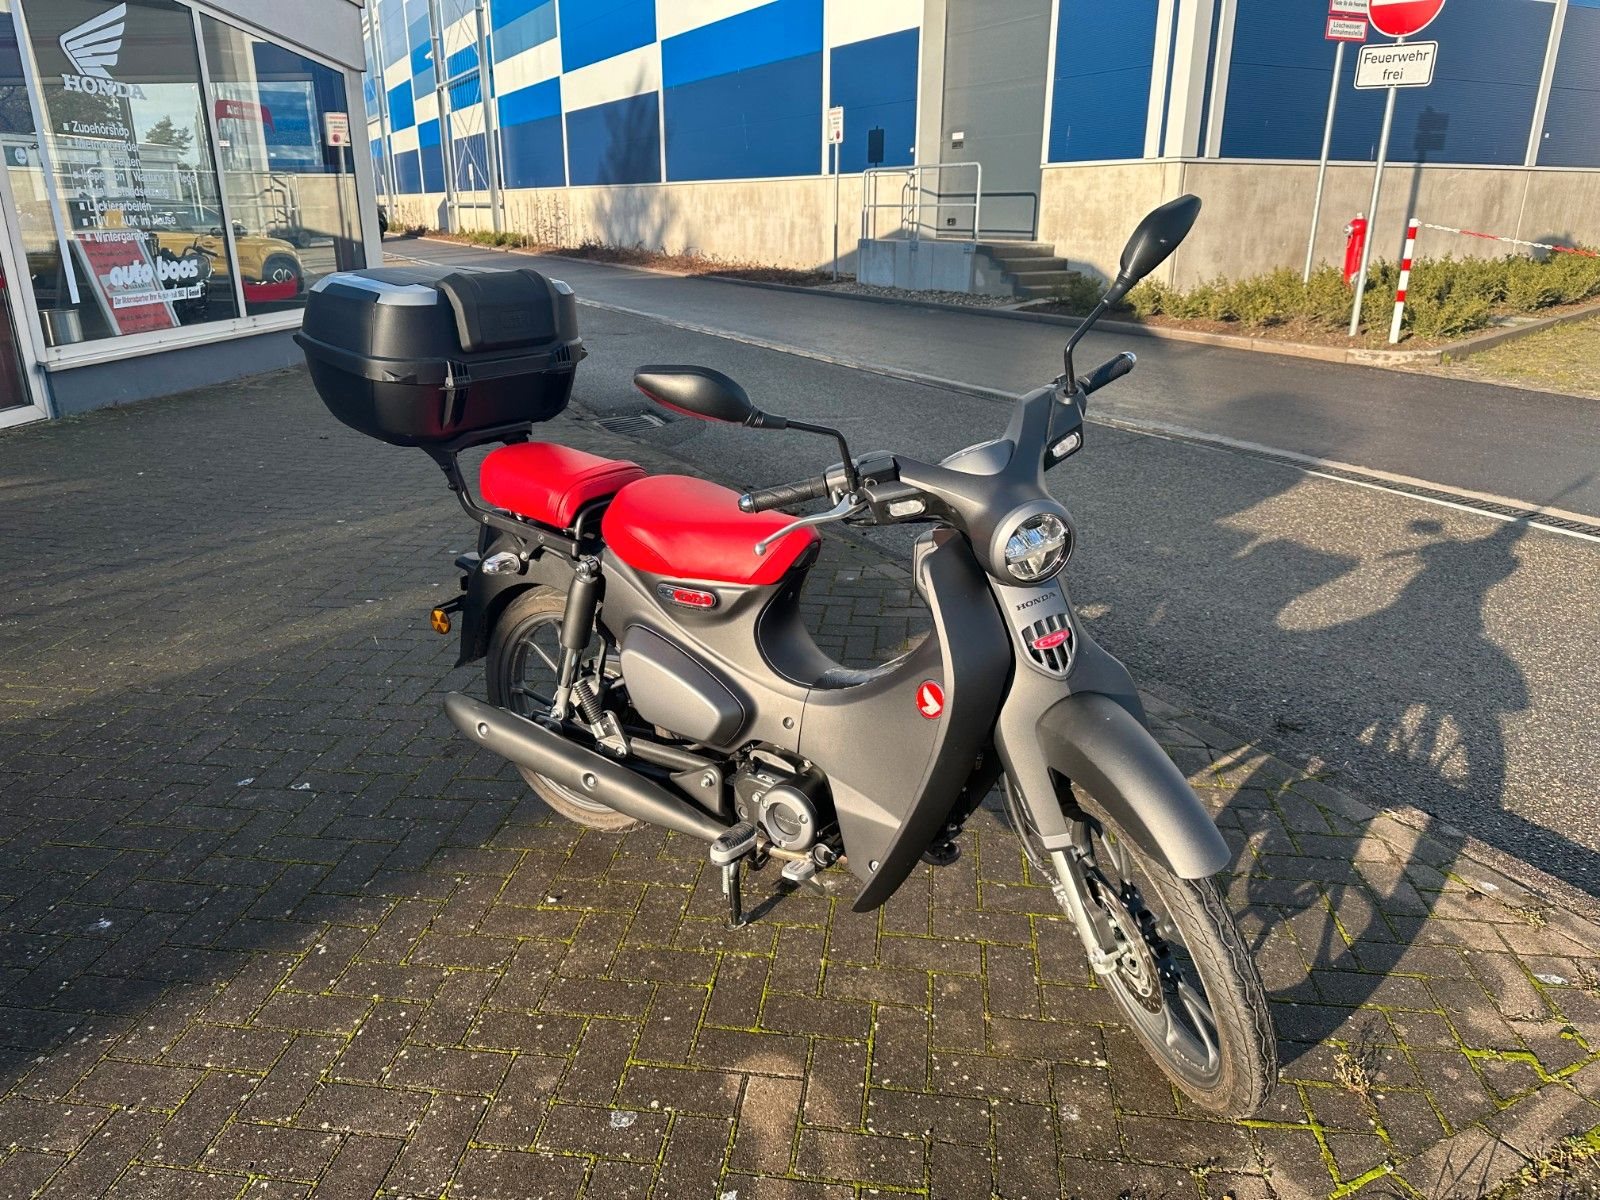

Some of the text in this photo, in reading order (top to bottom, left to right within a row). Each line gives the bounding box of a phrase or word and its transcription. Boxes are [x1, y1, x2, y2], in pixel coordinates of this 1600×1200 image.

[1363, 50, 1429, 64] Feuerwehr
[1382, 67, 1404, 81] frei
[61, 73, 147, 101] HONDA
[71, 121, 130, 139] Zubehörshop
[88, 200, 152, 212] Lackierarbeiten
[93, 230, 149, 244] Wintergarage
[109, 255, 199, 287] auto boos
[1016, 592, 1056, 611] HONDA
